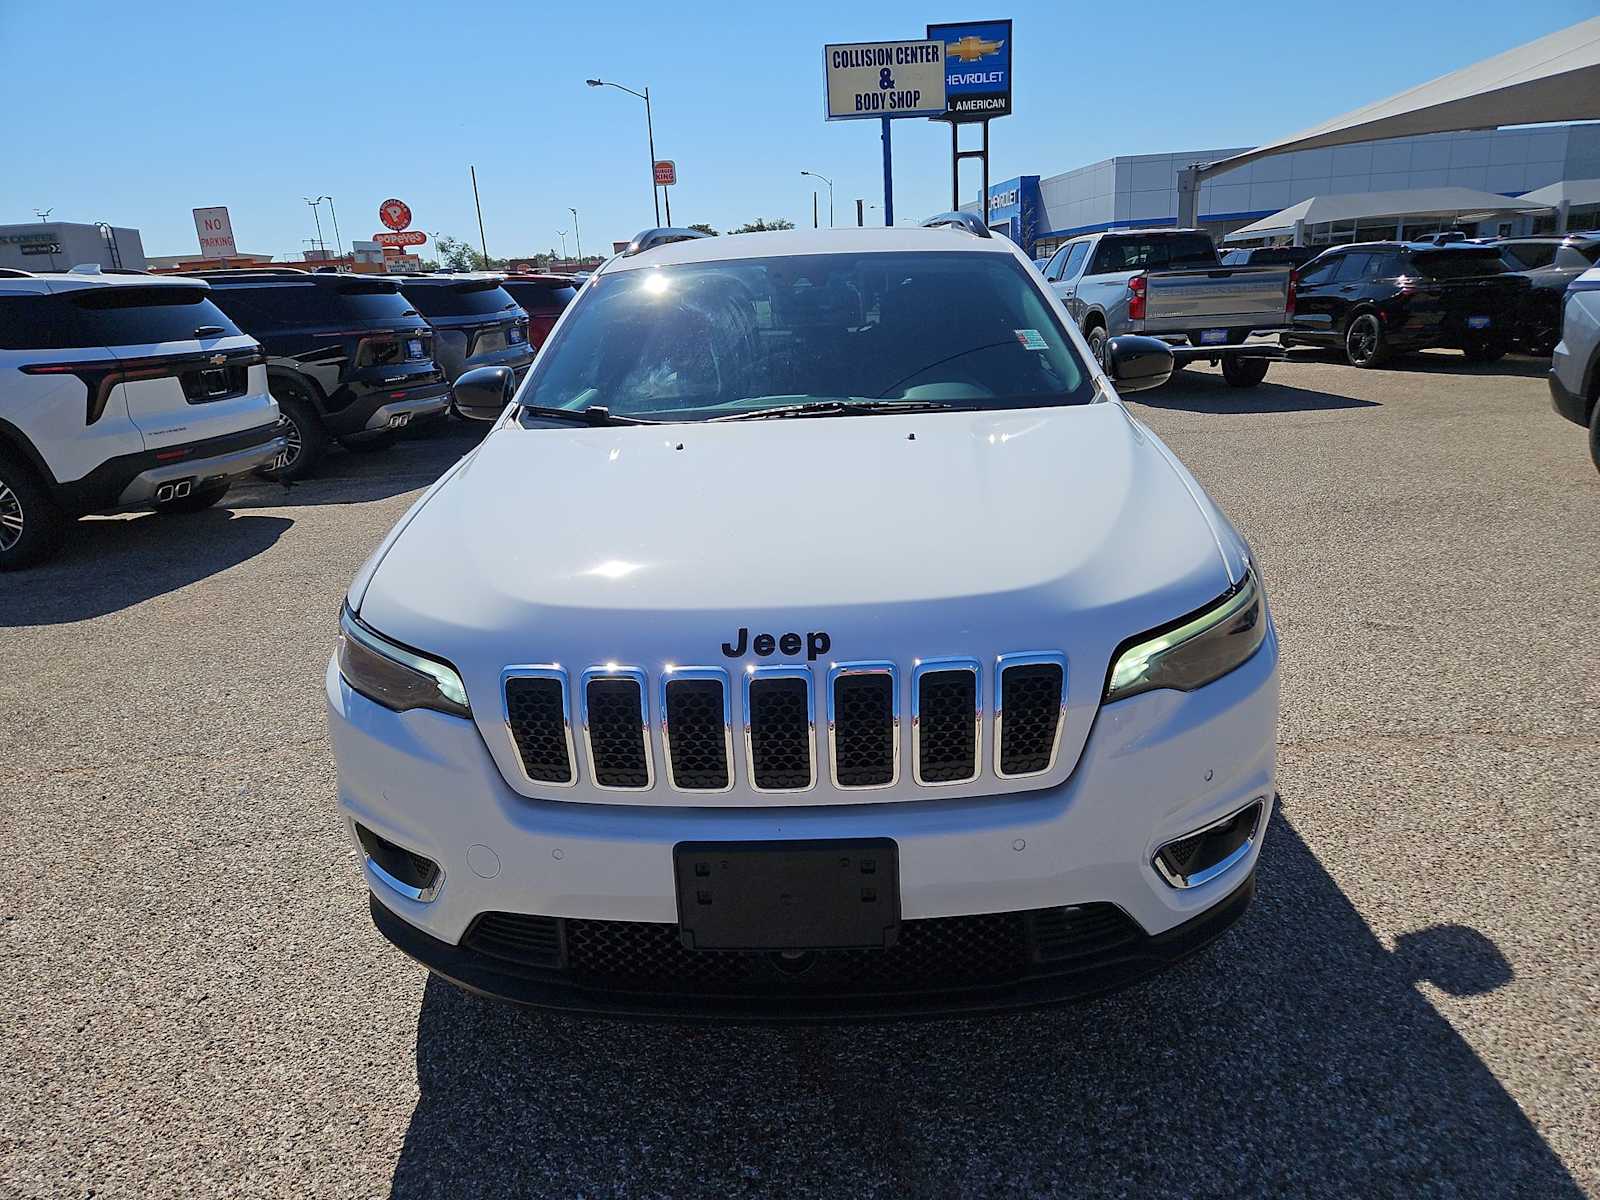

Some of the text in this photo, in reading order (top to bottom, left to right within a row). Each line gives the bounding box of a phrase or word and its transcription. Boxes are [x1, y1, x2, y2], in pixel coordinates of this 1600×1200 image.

[832, 44, 940, 69] COLLISION CENTER
[879, 67, 895, 90] &
[946, 71, 1004, 86] HEVROLET
[855, 90, 921, 112] BODY SHOP
[956, 98, 1006, 111] AMERICAN
[204, 218, 222, 231] NO
[201, 236, 233, 247] PARKING
[721, 627, 831, 661] Jeep
